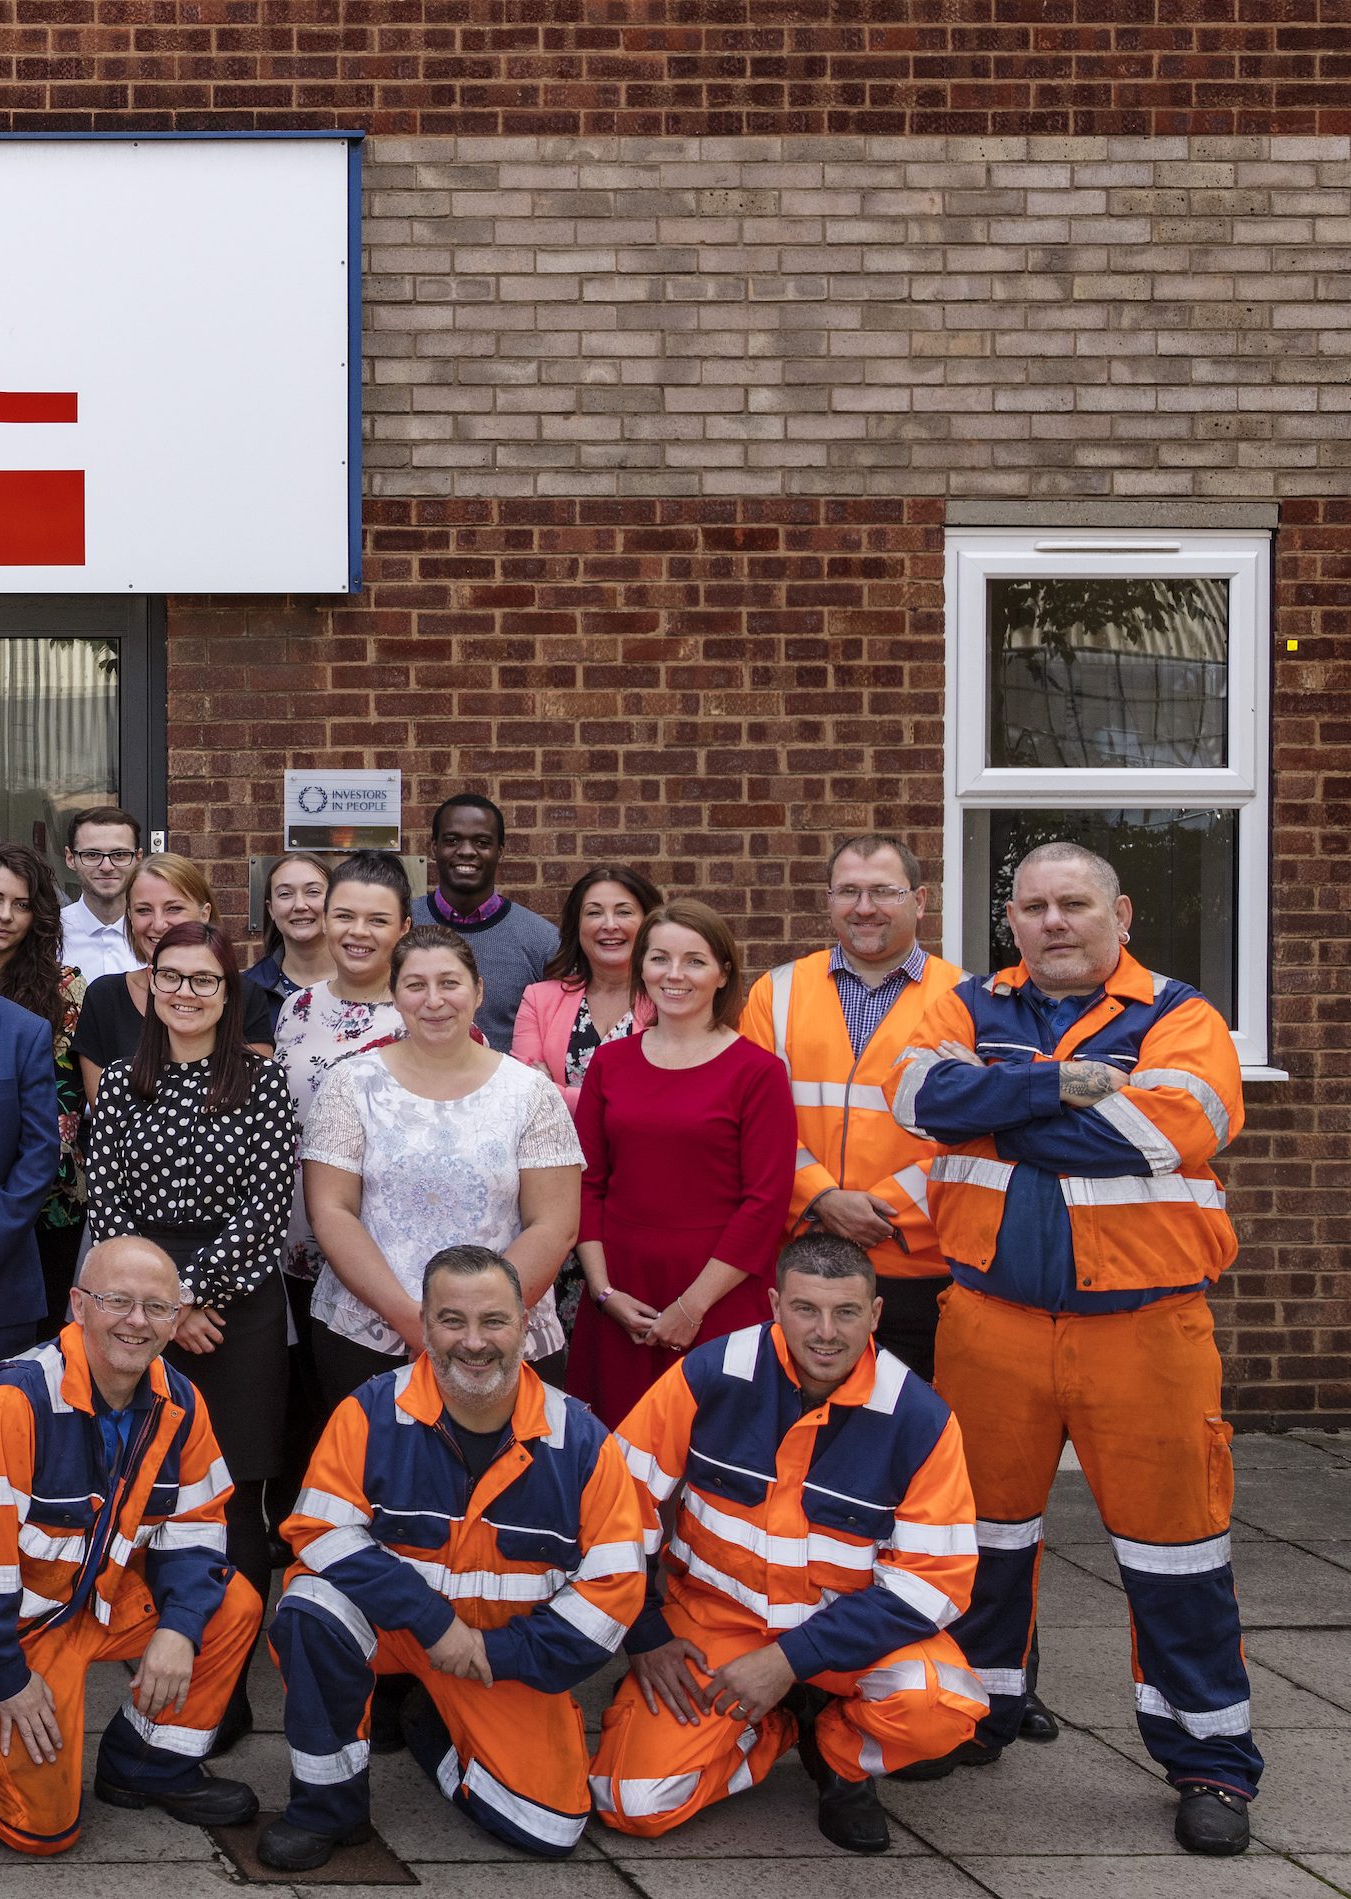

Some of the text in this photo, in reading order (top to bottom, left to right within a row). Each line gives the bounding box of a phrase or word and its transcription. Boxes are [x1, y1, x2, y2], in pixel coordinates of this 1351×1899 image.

[332, 789, 387, 799] INVESTORS
[332, 802, 387, 811] IN PEOPLE
